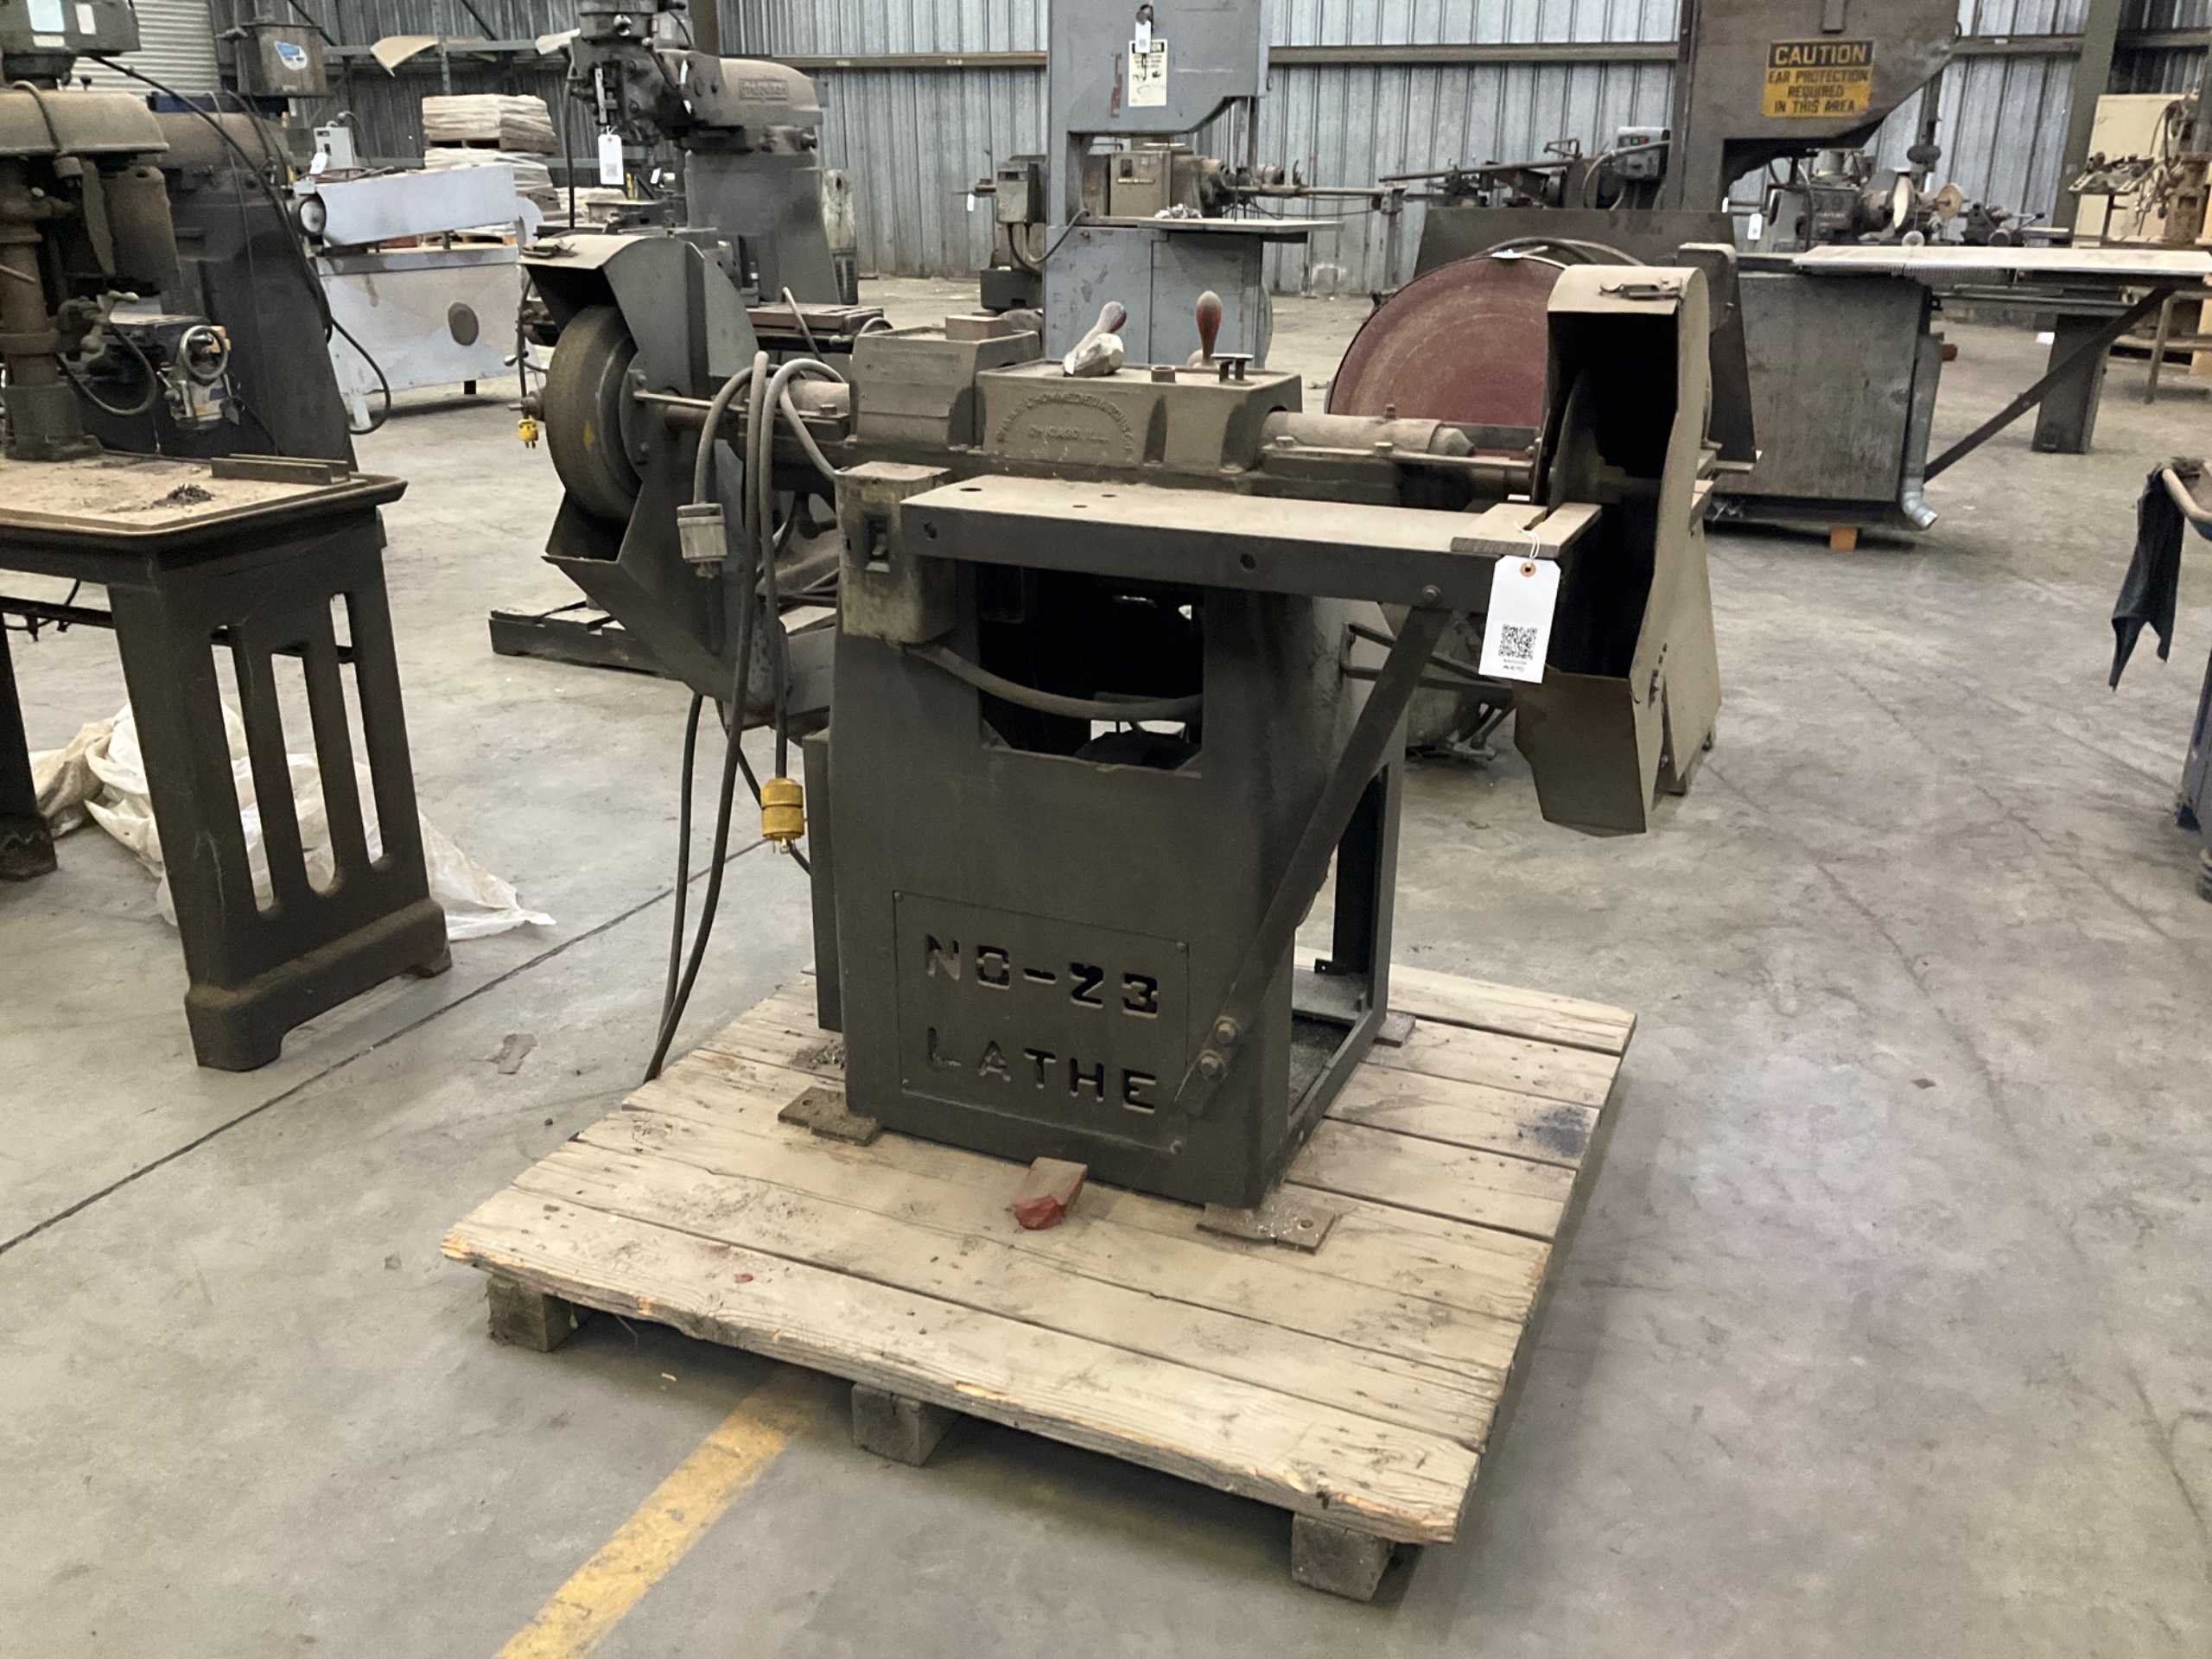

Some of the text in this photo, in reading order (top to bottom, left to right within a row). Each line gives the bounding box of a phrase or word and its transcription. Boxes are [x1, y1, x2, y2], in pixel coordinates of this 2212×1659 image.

[1774, 44, 1867, 66] CAUTION
[1768, 69, 1868, 84] EAR PROTECTION
[1788, 86, 1844, 99] REQUIRED
[1775, 99, 1855, 113] IN THIS AREA
[926, 1026, 1157, 1115] LATHE
